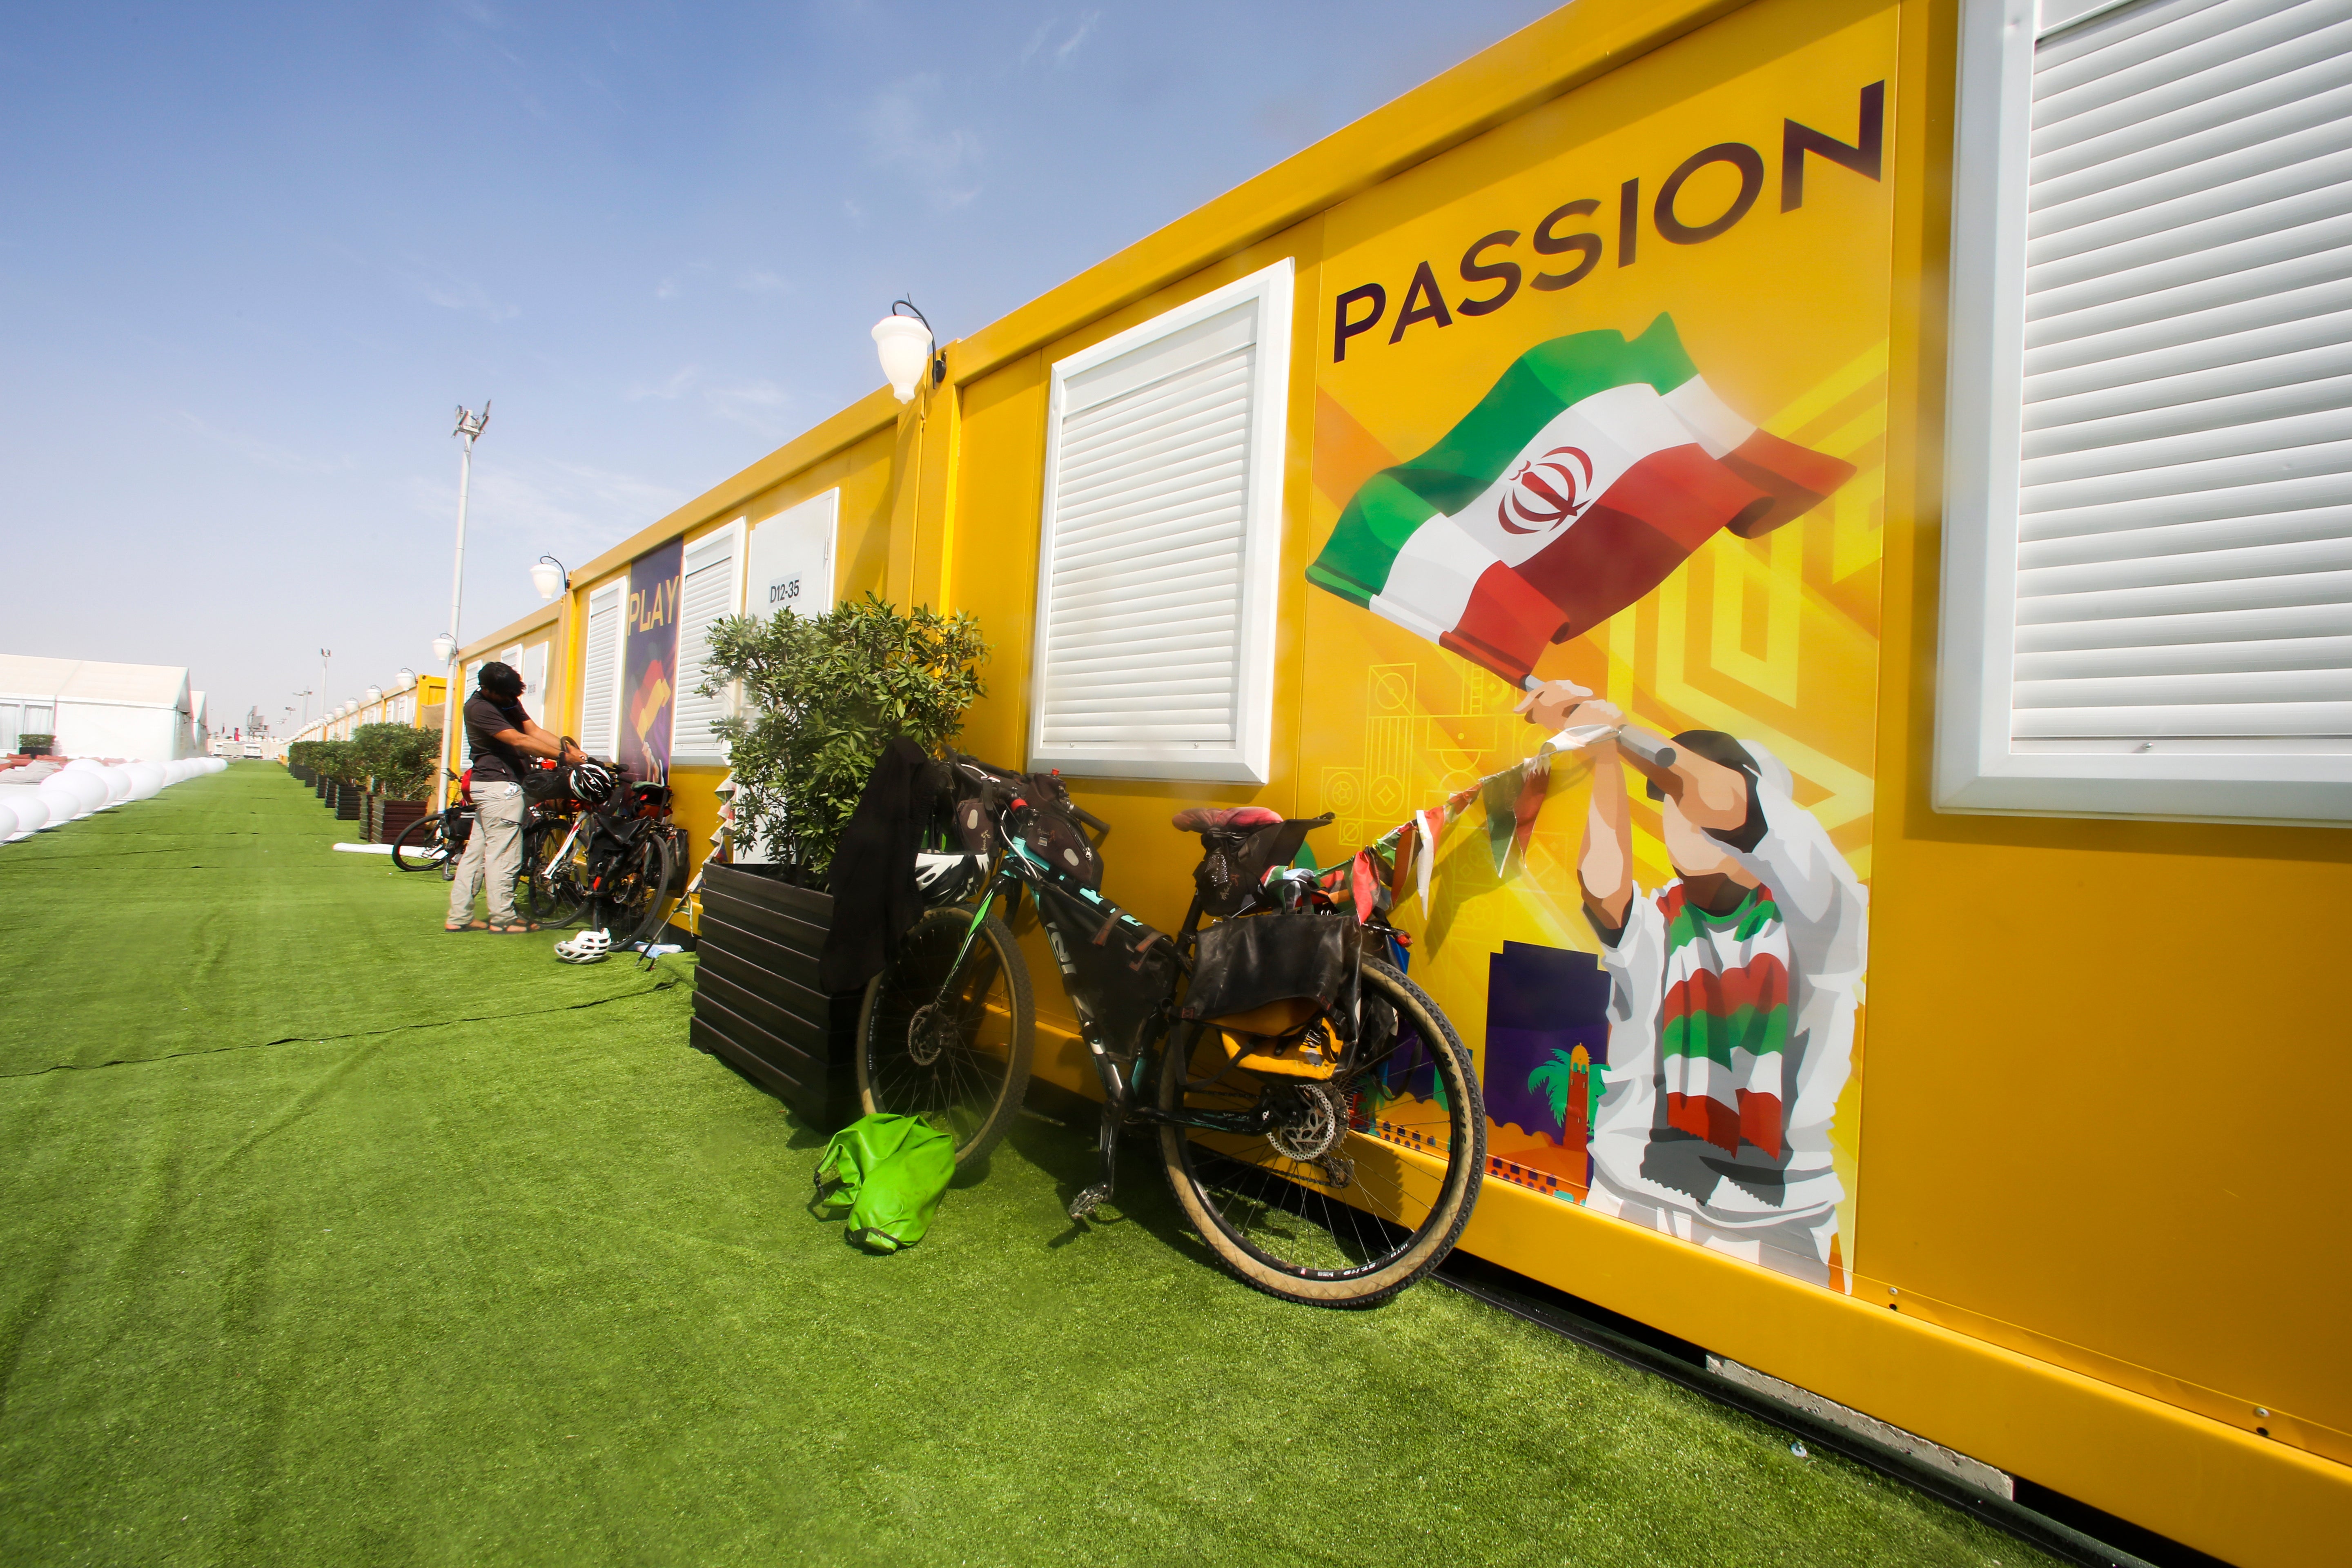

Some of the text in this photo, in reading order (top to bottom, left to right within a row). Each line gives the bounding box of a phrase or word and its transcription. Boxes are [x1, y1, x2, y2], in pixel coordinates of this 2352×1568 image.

[1333, 79, 1885, 364] PASSION
[628, 575, 679, 636] PLAY
[770, 579, 800, 603] D12-35
[1440, 1052, 1467, 1144] MAXXIS
